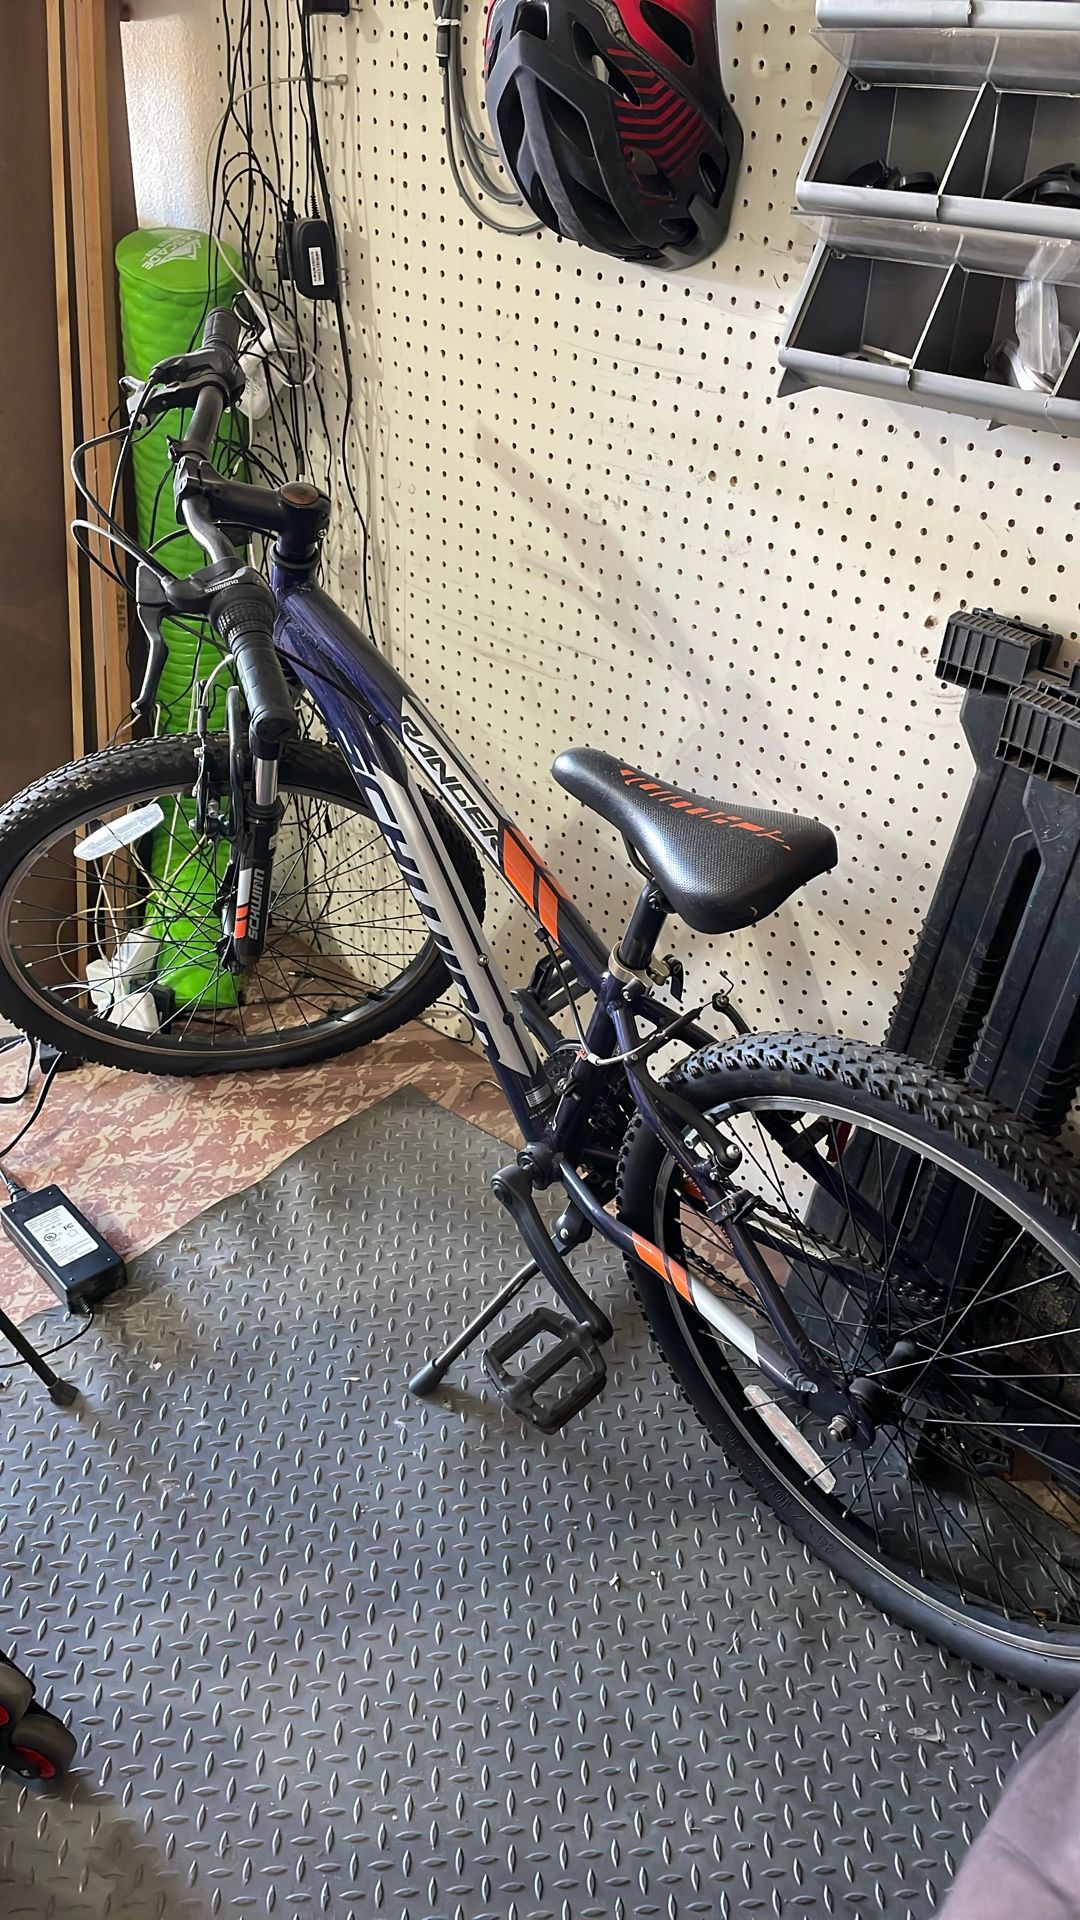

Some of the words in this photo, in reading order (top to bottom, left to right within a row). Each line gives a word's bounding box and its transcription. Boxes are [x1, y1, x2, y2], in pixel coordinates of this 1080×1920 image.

[204, 579, 239, 594] SHIMANO
[401, 715, 501, 852] RANGER
[248, 868, 265, 940] SCHWINN
